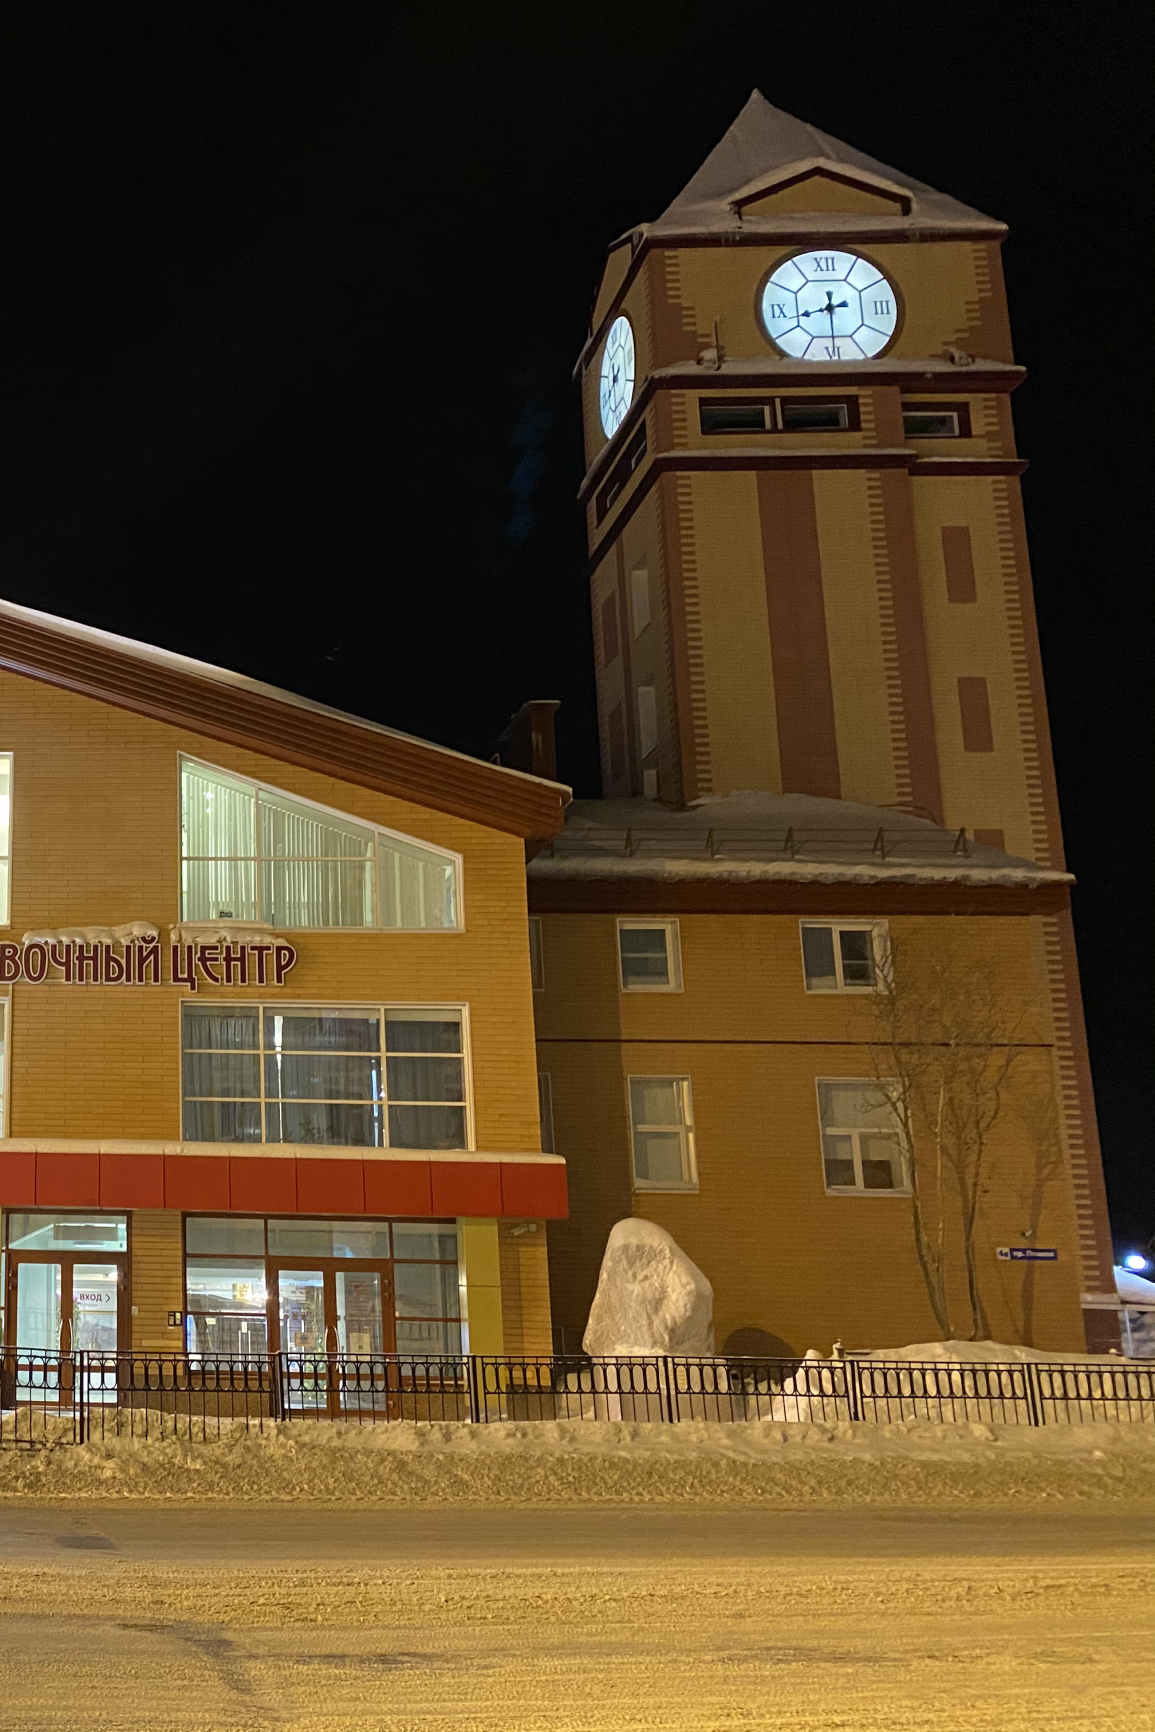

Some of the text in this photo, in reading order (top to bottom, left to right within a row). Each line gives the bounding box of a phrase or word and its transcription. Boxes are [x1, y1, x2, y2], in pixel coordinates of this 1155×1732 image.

[813, 257, 836, 272] XII
[770, 303, 787, 319] IX
[873, 300, 891, 315] III
[171, 943, 296, 992] ЦЕНТР
[79, 1293, 103, 1302] ВХОД
